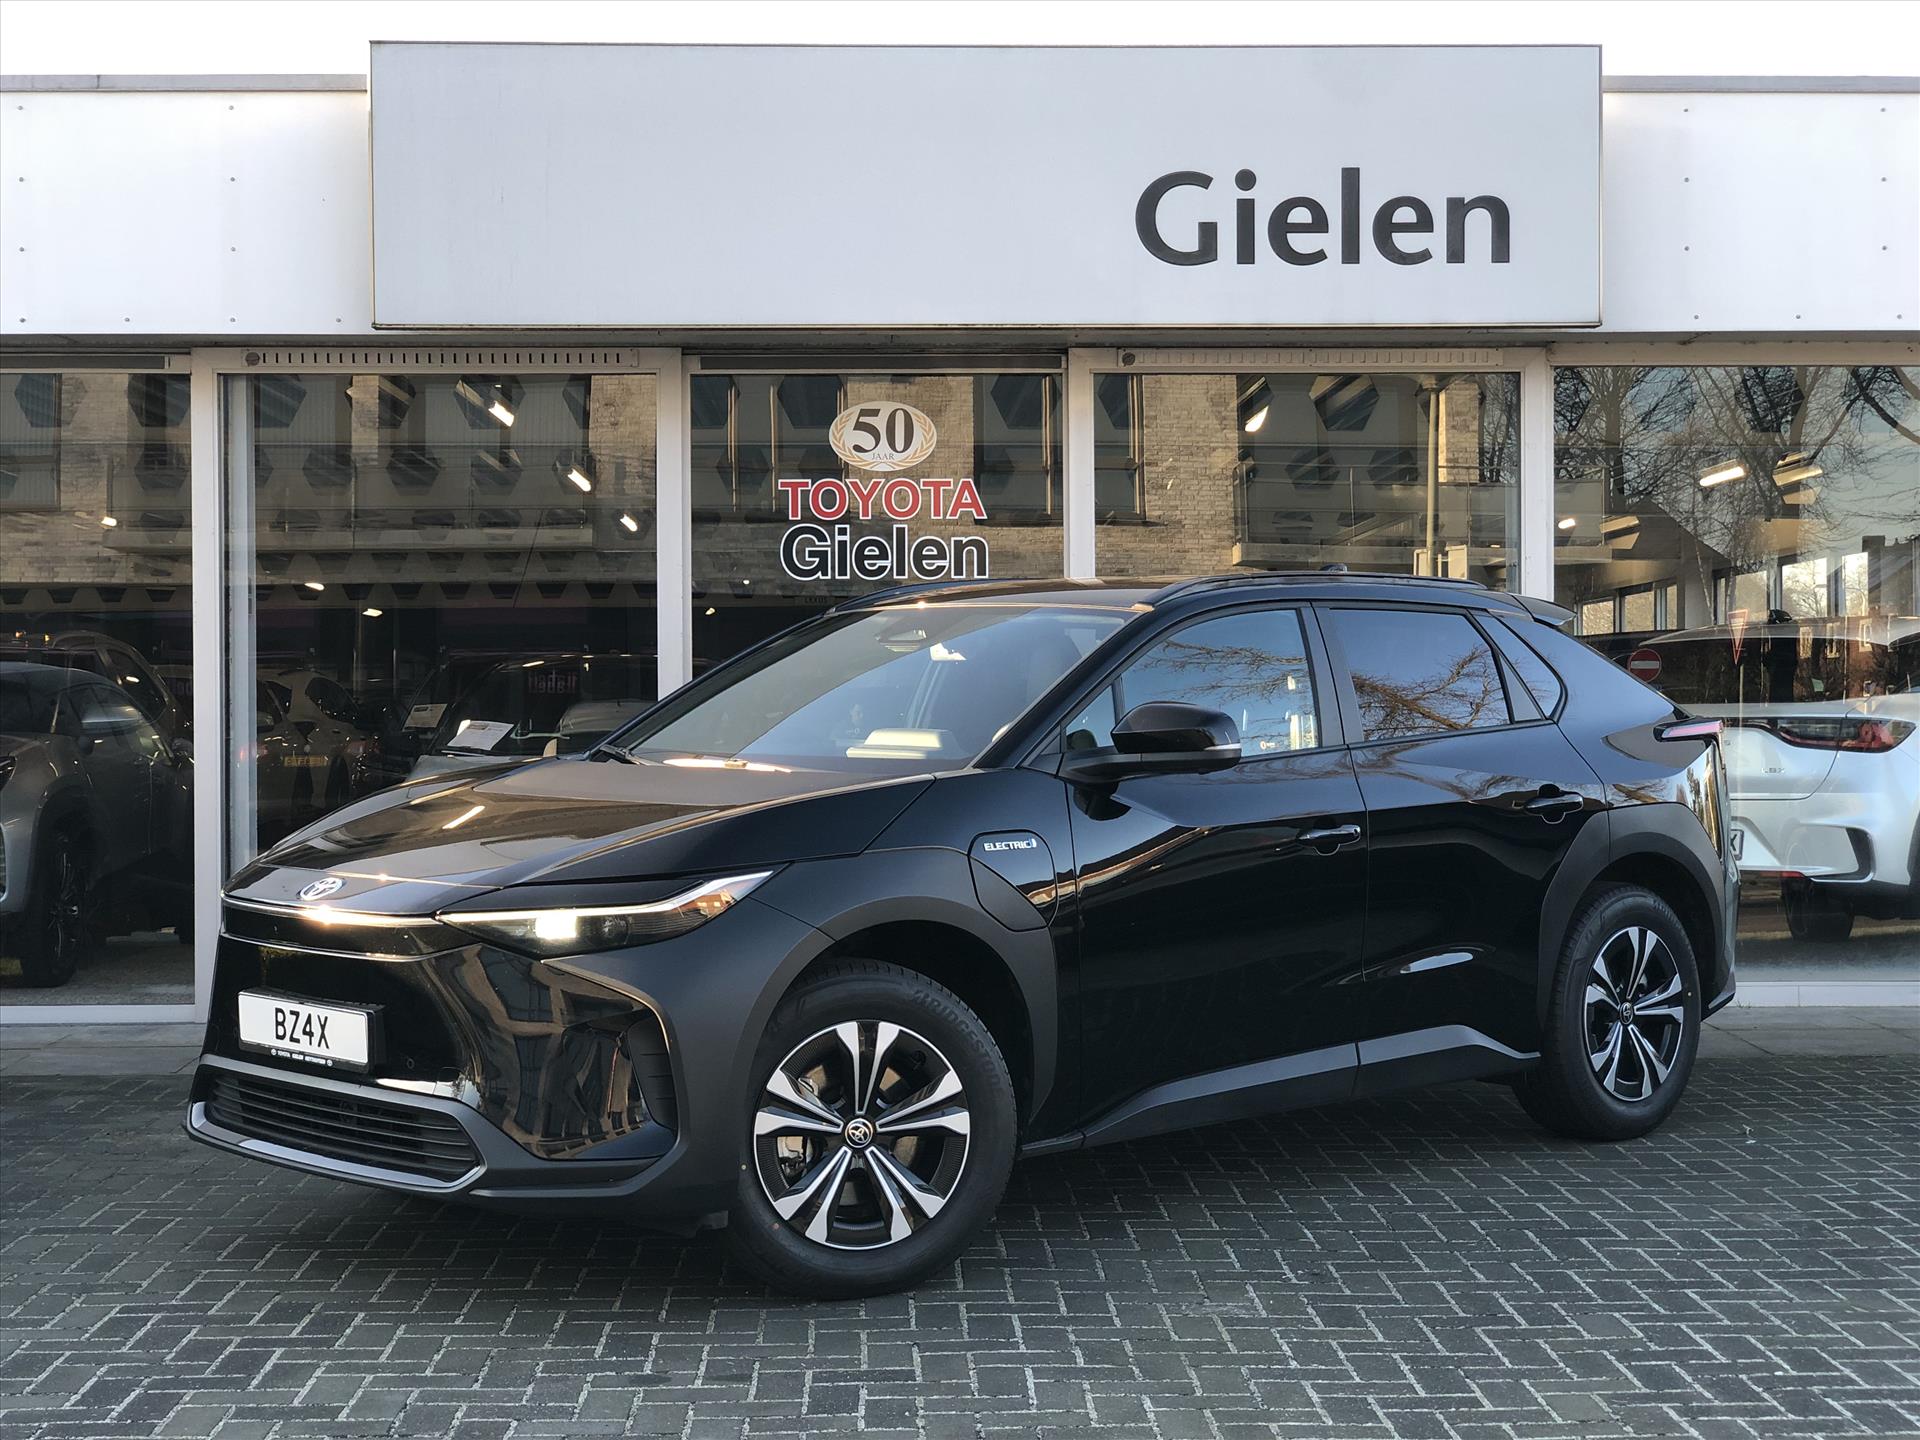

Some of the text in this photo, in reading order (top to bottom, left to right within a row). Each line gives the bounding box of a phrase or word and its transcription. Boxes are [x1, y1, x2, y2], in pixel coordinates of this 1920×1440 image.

[1135, 166, 1510, 266] Gielen
[852, 407, 914, 454] 50
[871, 451, 895, 462] JAAR
[778, 478, 988, 520] TOYOTA
[779, 523, 990, 581] Gielen
[983, 840, 1032, 851] ELECTRIC
[275, 1008, 330, 1049] BZ4X
